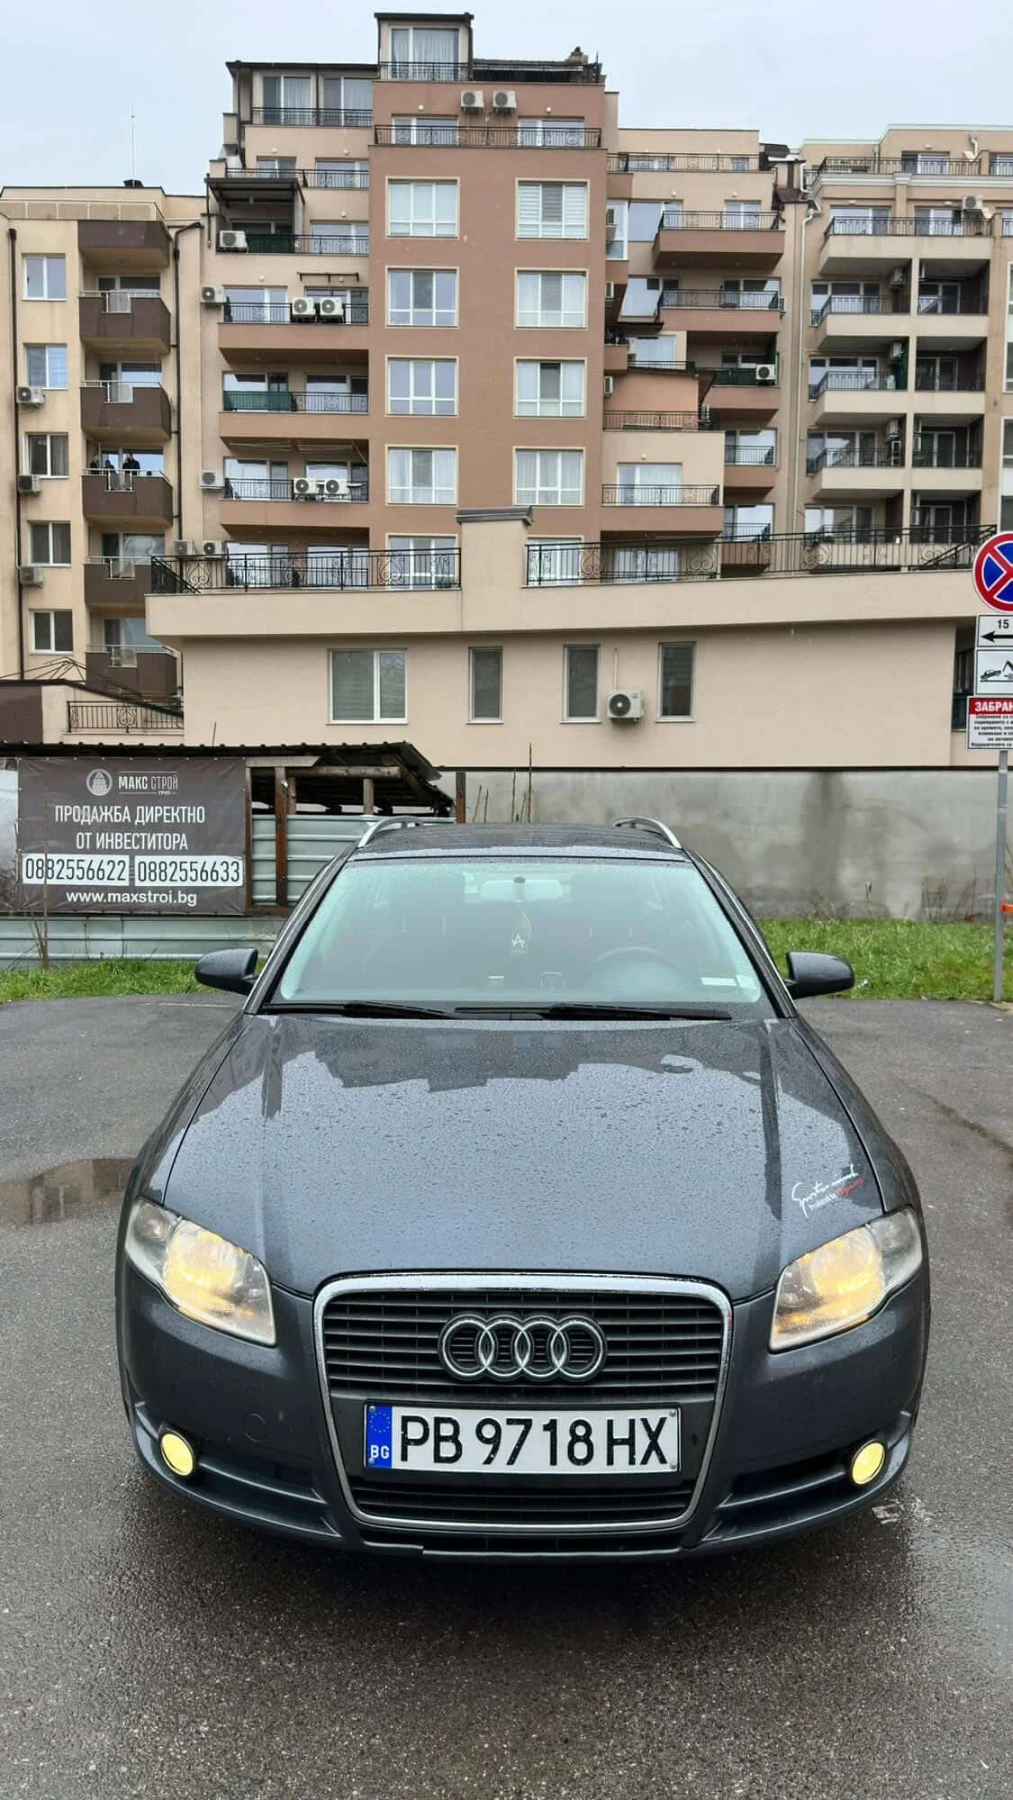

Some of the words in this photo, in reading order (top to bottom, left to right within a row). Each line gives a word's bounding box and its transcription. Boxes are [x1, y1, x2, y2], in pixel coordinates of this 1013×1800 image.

[997, 619, 1010, 629] 15
[118, 776, 148, 790] МАКС
[150, 774, 178, 790] СТРОЙ
[55, 805, 131, 825] ПРОДАЖБА
[135, 806, 205, 825] ДИРЕКТНО
[76, 832, 91, 849] ОТ
[96, 833, 188, 850] ИНВЕСТИТОРА
[25, 858, 126, 881] 0882556622
[138, 860, 240, 882] 0882556633
[66, 890, 197, 906] www.maxstroi.bg
[400, 1415, 463, 1464] PB
[475, 1417, 595, 1467] 9718
[606, 1417, 668, 1466] HX
[370, 1445, 390, 1459] BG
